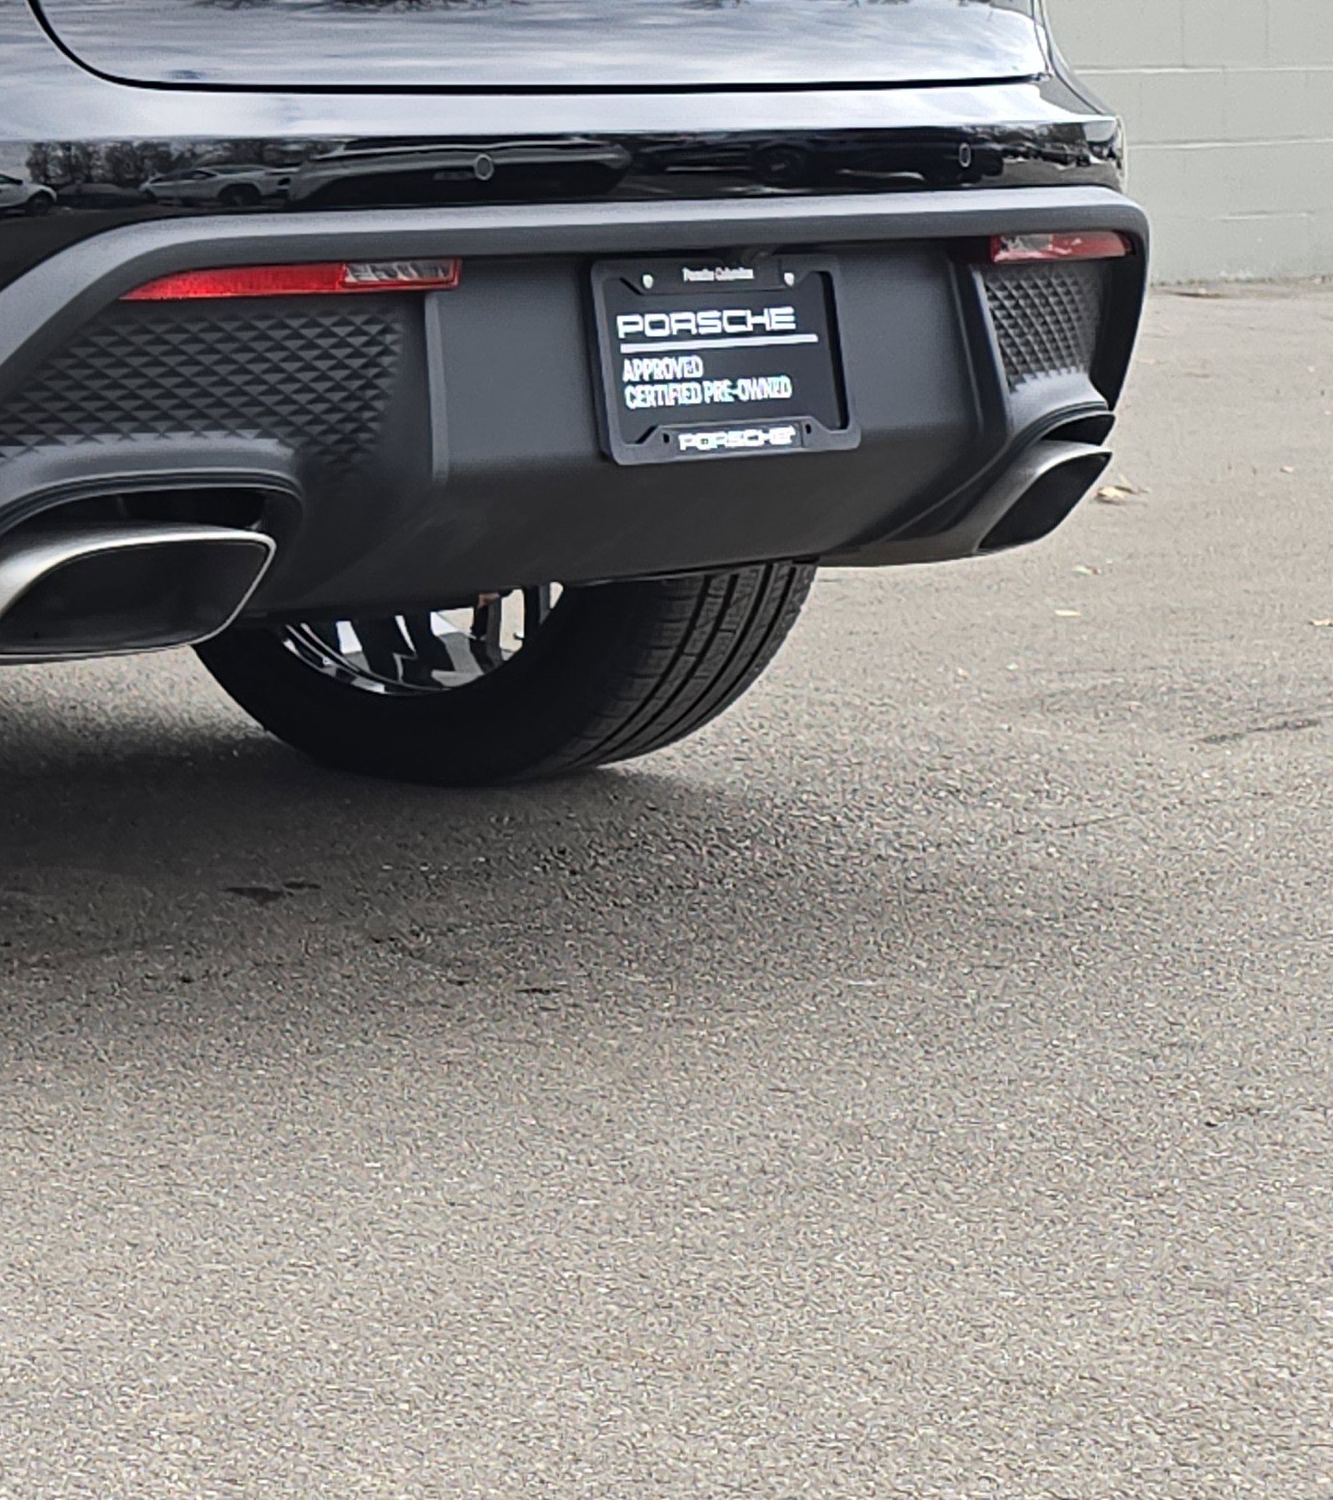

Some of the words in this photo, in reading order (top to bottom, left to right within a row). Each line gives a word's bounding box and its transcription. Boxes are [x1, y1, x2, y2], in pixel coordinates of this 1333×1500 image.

[616, 306, 796, 338] PORSCHE
[622, 355, 704, 382] APPROVED
[624, 381, 703, 409] CERTIFIED
[704, 375, 793, 404] PRE-OWNED
[677, 426, 797, 451] PORSCHE
